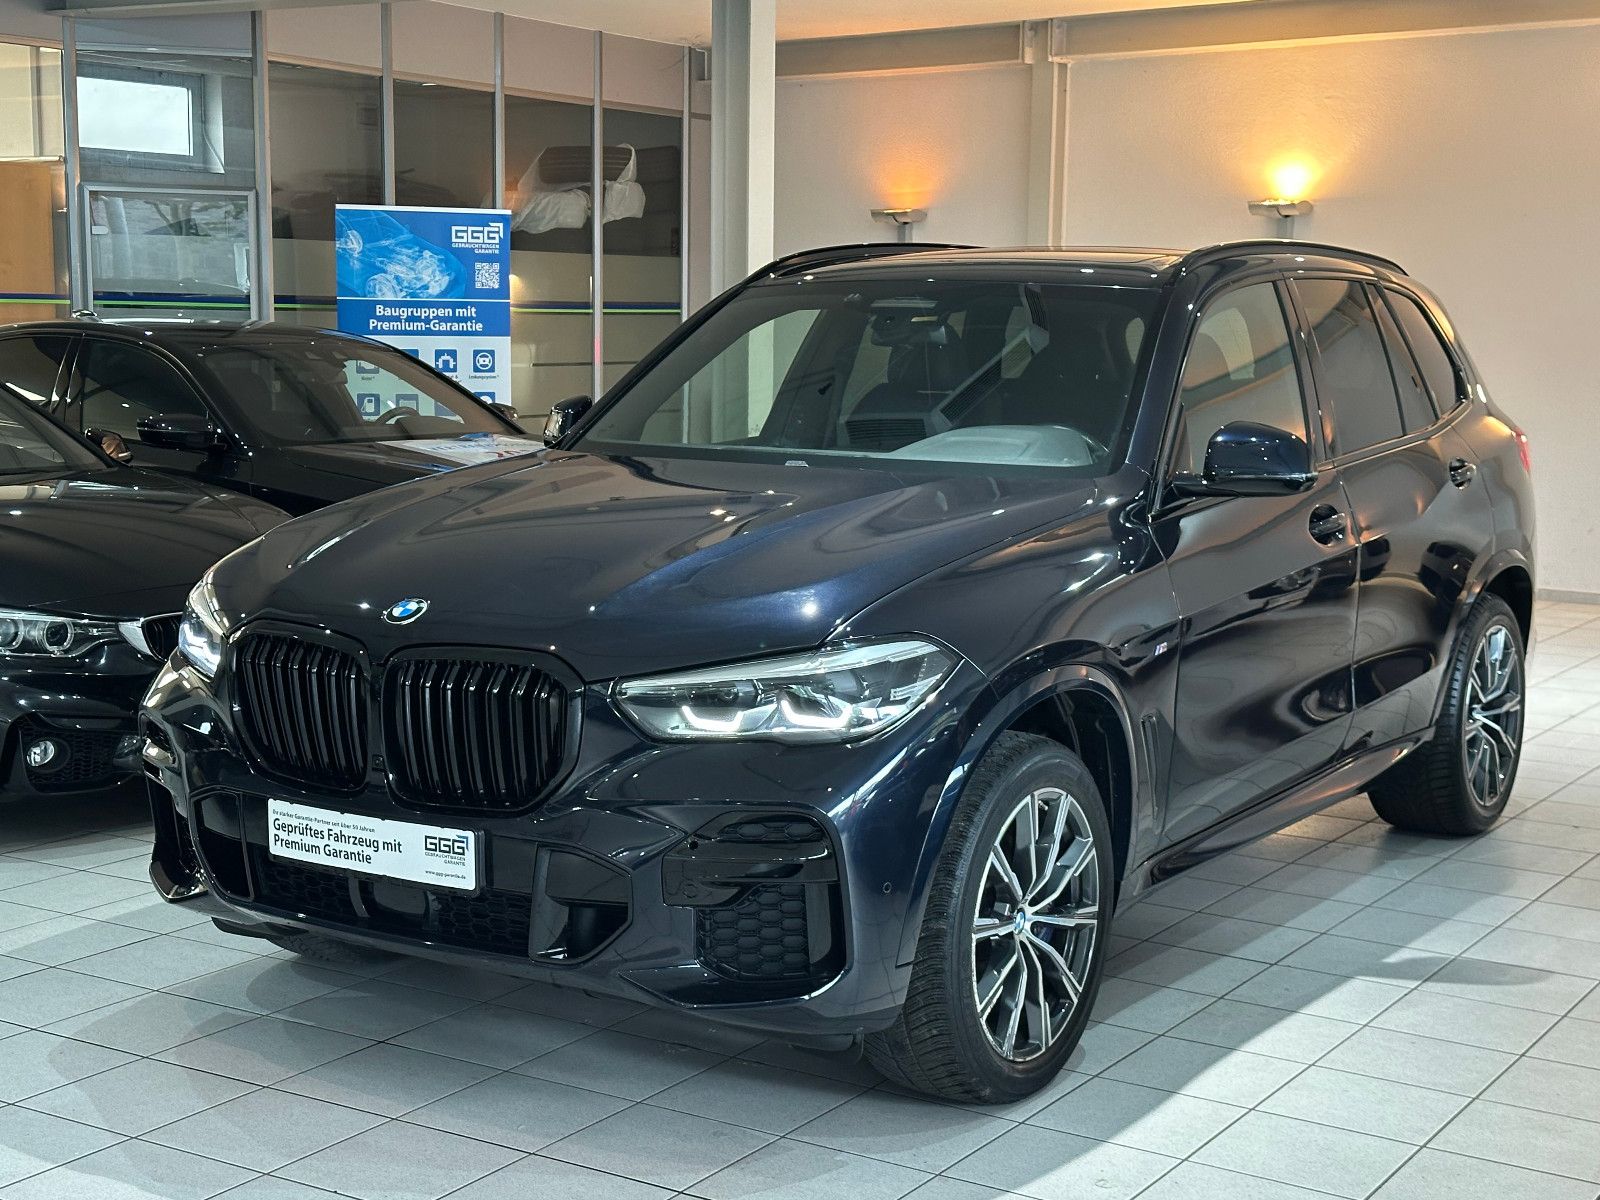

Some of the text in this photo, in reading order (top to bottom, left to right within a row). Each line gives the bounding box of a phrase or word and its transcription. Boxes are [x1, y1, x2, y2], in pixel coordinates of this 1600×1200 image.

[452, 225, 500, 244] GGG
[375, 304, 477, 319] Baugruppen mit
[369, 318, 483, 332] Premium-Garantie
[273, 817, 403, 854] Geprüftes Fahrzeug mit
[424, 834, 466, 857] GGG
[273, 833, 372, 864] Premium Garantie
